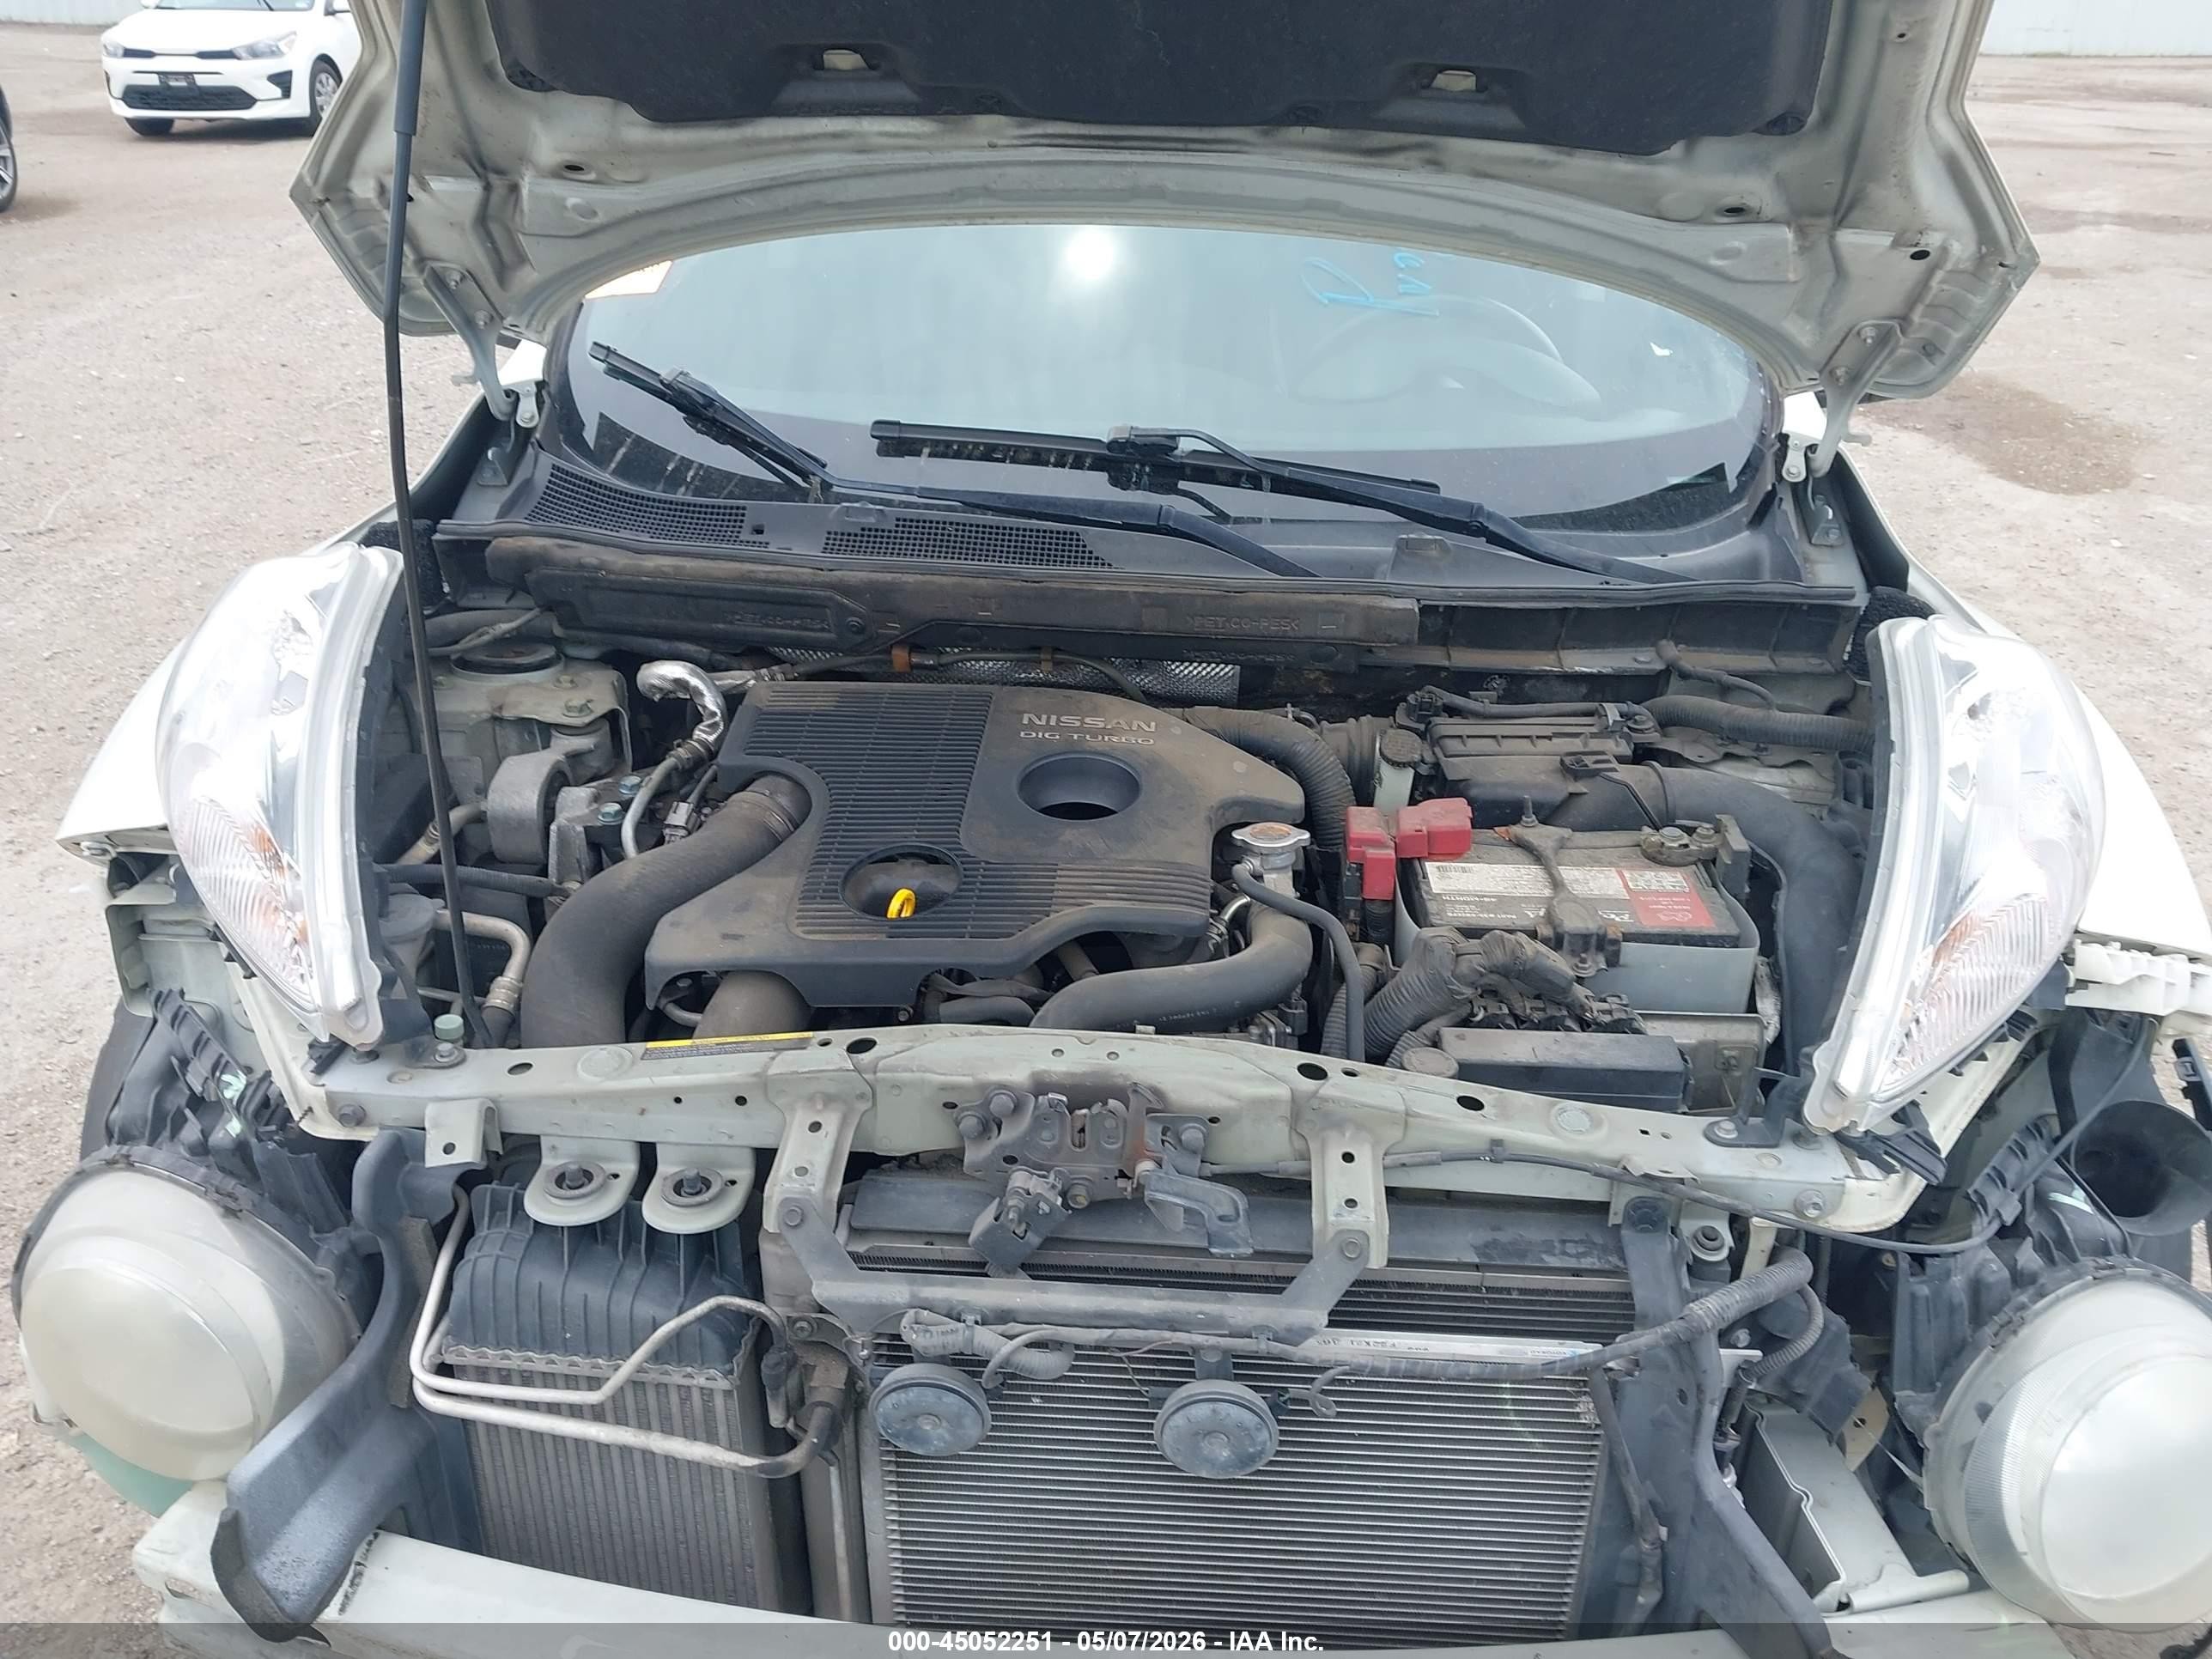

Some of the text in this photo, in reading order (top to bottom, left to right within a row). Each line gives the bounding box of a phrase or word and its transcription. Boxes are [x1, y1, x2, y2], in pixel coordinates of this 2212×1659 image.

[1021, 713, 1156, 732] NISSAN
[1019, 731, 1155, 745] DIG TURBO
